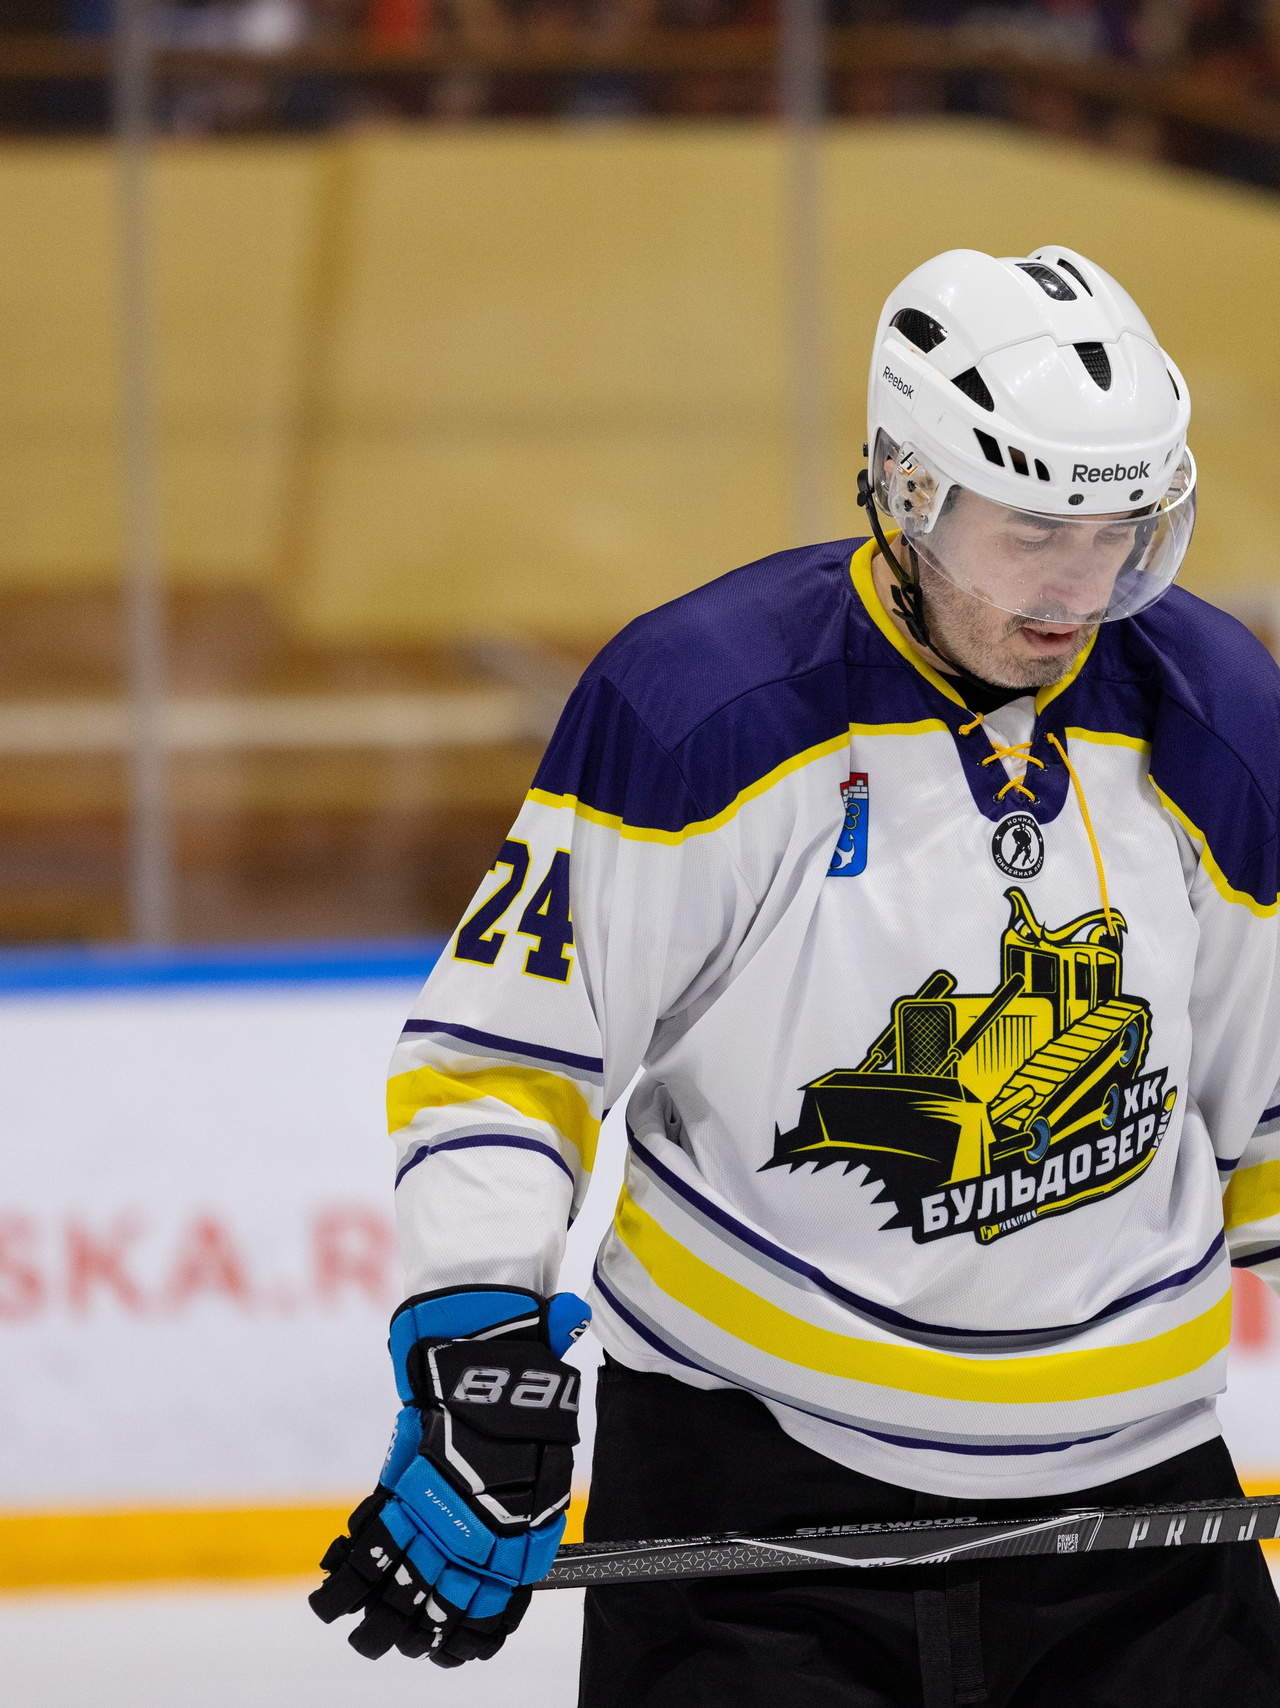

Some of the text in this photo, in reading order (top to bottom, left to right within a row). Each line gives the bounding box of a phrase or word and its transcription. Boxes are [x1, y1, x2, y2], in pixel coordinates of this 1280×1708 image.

[883, 366, 914, 399] Reebok
[1072, 461, 1151, 482] Reebok
[1006, 817, 1035, 827] НОЧНАЯ
[995, 853, 1033, 877] ХОККЕЙНАЯ
[452, 836, 576, 986] 24
[1123, 1075, 1162, 1119] ХК
[921, 1113, 1156, 1234] БУЛЬДОЗЕР
[796, 1516, 978, 1536] SHER-WOOD
[1057, 1533, 1079, 1543] POWER
